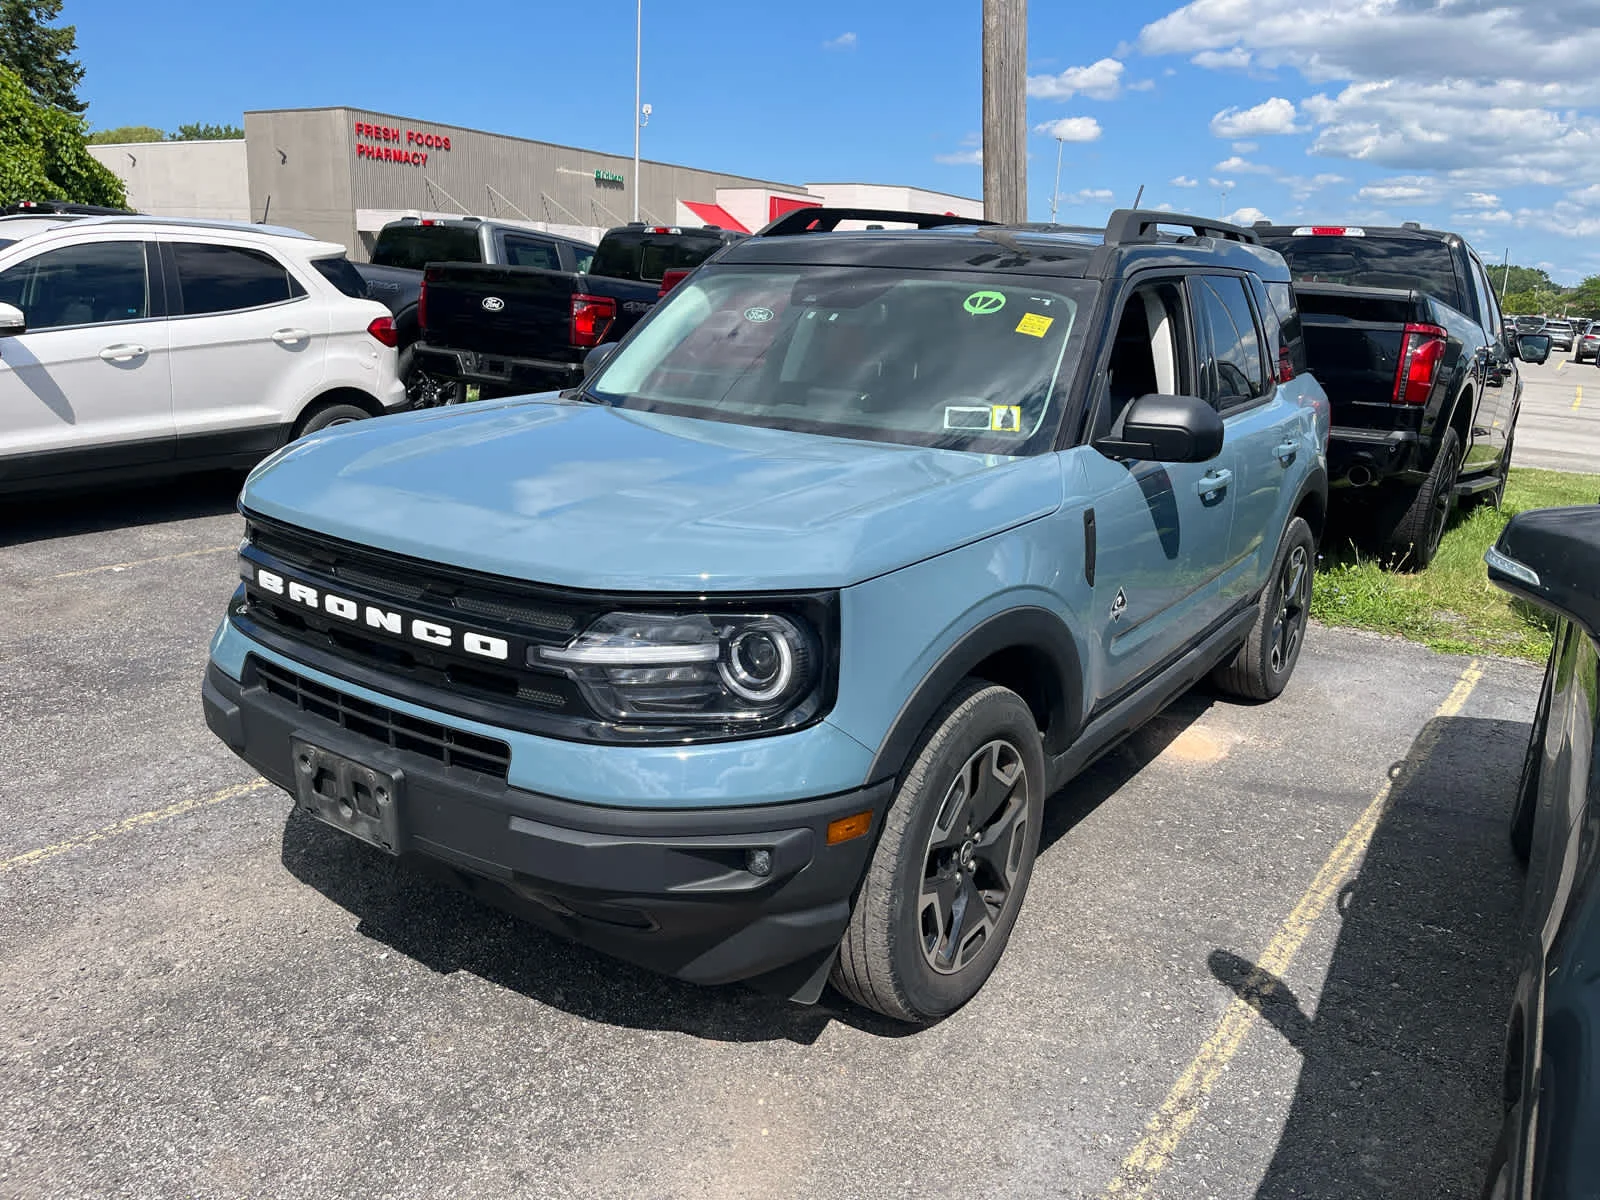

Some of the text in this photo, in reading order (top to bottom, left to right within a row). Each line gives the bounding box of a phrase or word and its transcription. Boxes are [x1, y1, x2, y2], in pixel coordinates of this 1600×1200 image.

[355, 121, 451, 151] FRESH FOODS
[356, 143, 428, 166] PHARMACY
[484, 298, 502, 309] Ford
[258, 569, 508, 660] BRONCO
